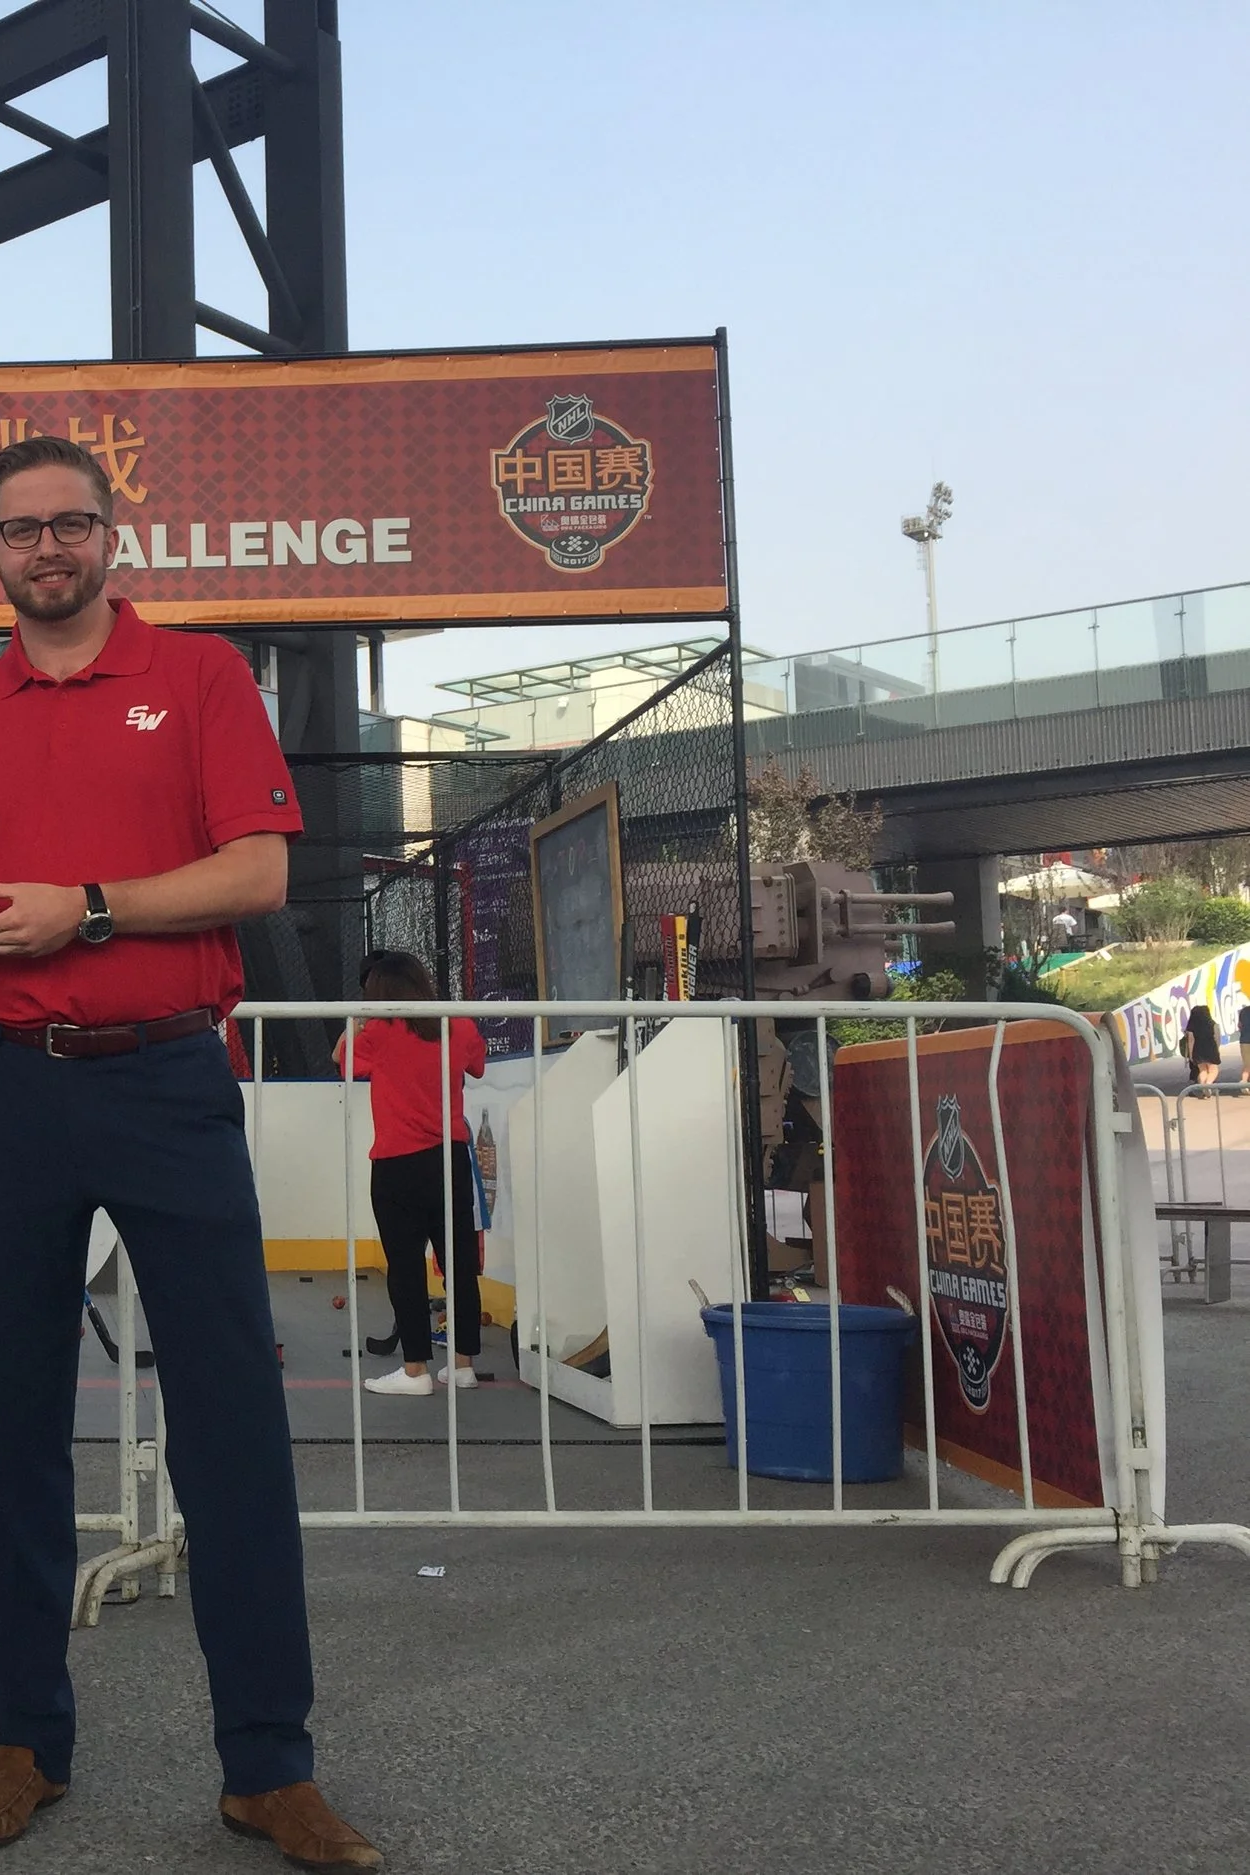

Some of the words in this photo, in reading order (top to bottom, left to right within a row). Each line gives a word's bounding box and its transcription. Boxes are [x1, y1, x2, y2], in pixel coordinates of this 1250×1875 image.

[557, 408, 585, 434] NHL
[499, 445, 643, 494] 中国赛
[506, 497, 565, 513] CHINA
[570, 494, 643, 510] GAMES
[563, 557, 589, 566] 2017
[126, 704, 168, 731] SW
[929, 1268, 961, 1299] CHINA
[961, 1276, 1006, 1310] GAMES
